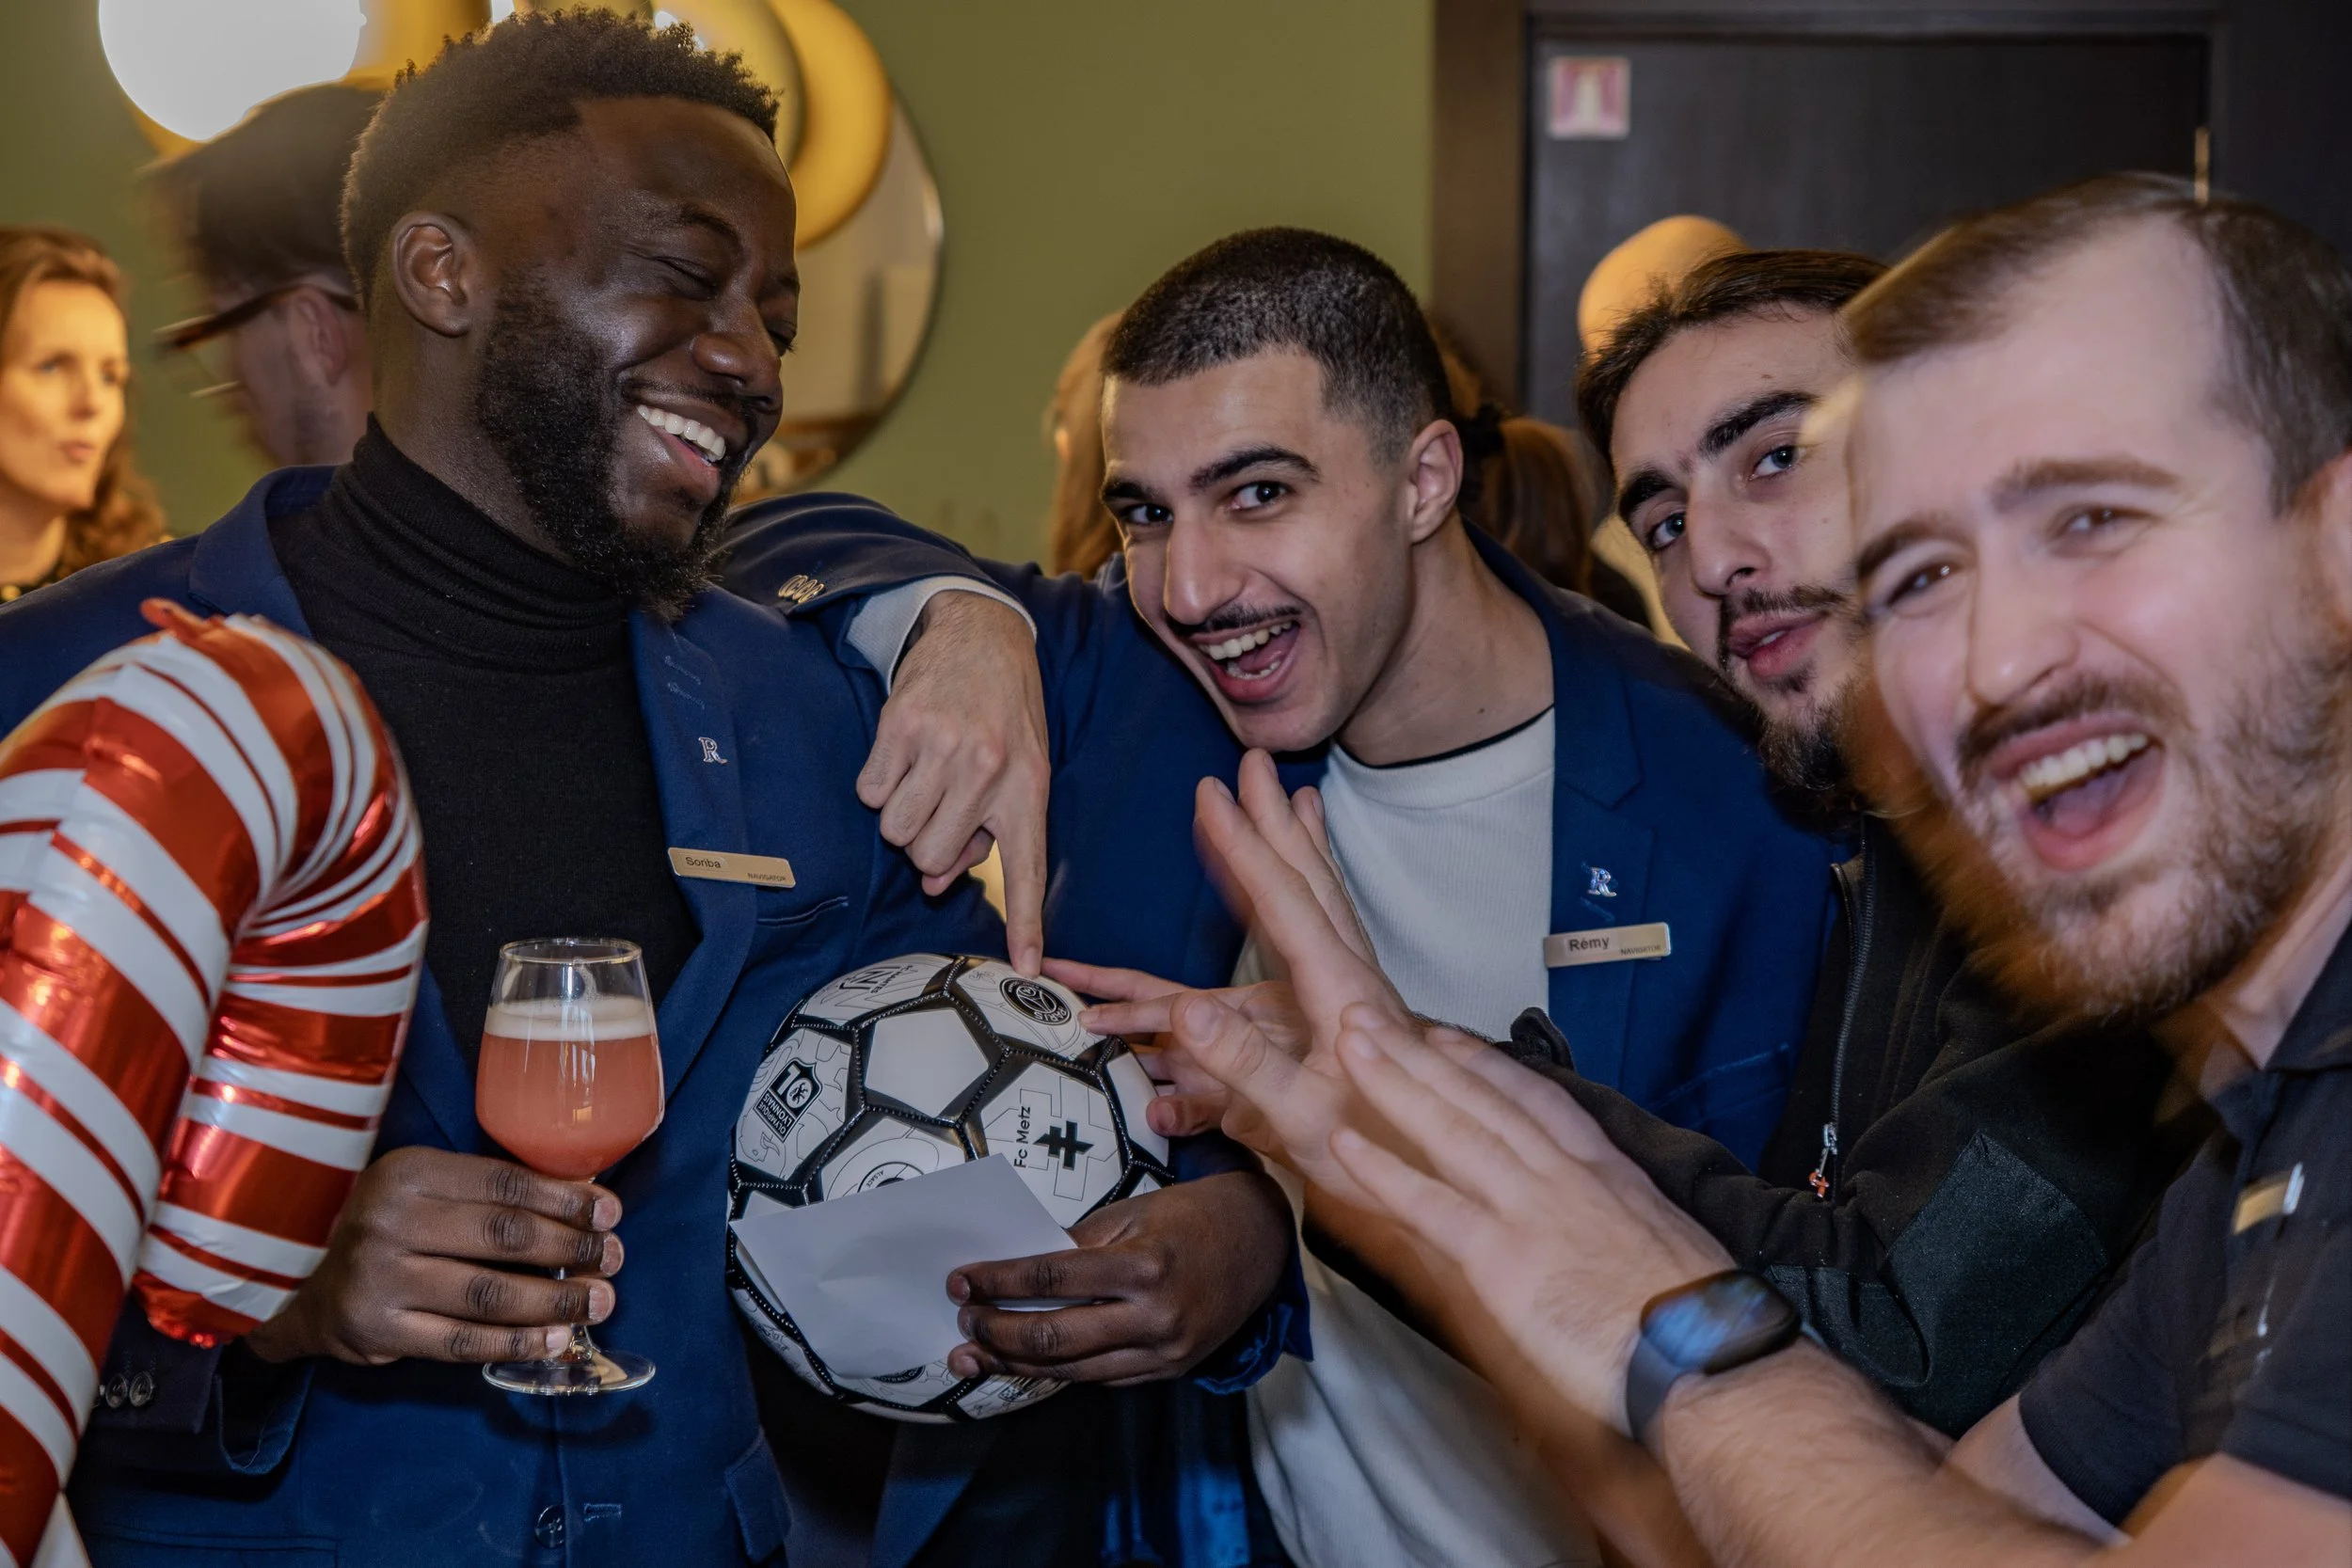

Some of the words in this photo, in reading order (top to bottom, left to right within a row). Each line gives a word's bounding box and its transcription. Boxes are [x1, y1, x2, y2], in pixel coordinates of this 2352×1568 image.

[685, 856, 722, 868] Soriba
[1568, 936, 1610, 952] Rémy
[1033, 1006, 1067, 1022] PARIS
[757, 1101, 787, 1135] OLYMPIQUE
[763, 1092, 793, 1128] LYONNAIS
[1016, 1105, 1031, 1145] Metz
[1013, 1148, 1028, 1168] Fc
[866, 1169, 884, 1188] ALSACE
